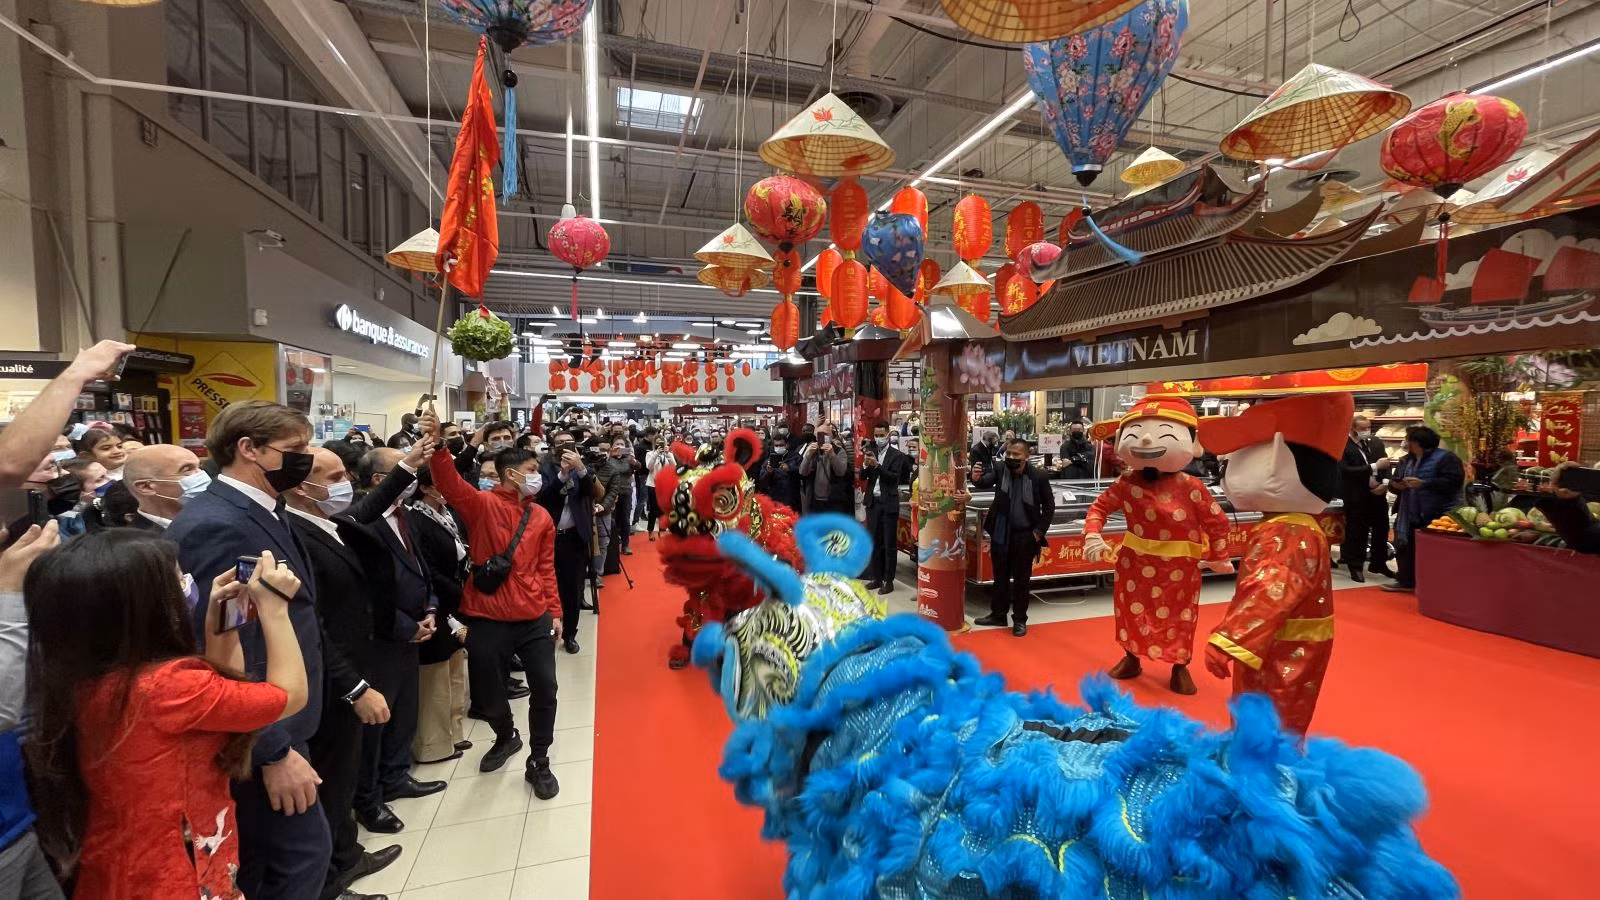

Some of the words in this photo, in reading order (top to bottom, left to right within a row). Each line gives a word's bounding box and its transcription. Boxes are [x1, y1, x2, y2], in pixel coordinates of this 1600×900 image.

[353, 309, 388, 345] banque
[388, 326, 394, 346] &
[394, 333, 430, 358] assurances
[1072, 329, 1199, 368] VIETNAM
